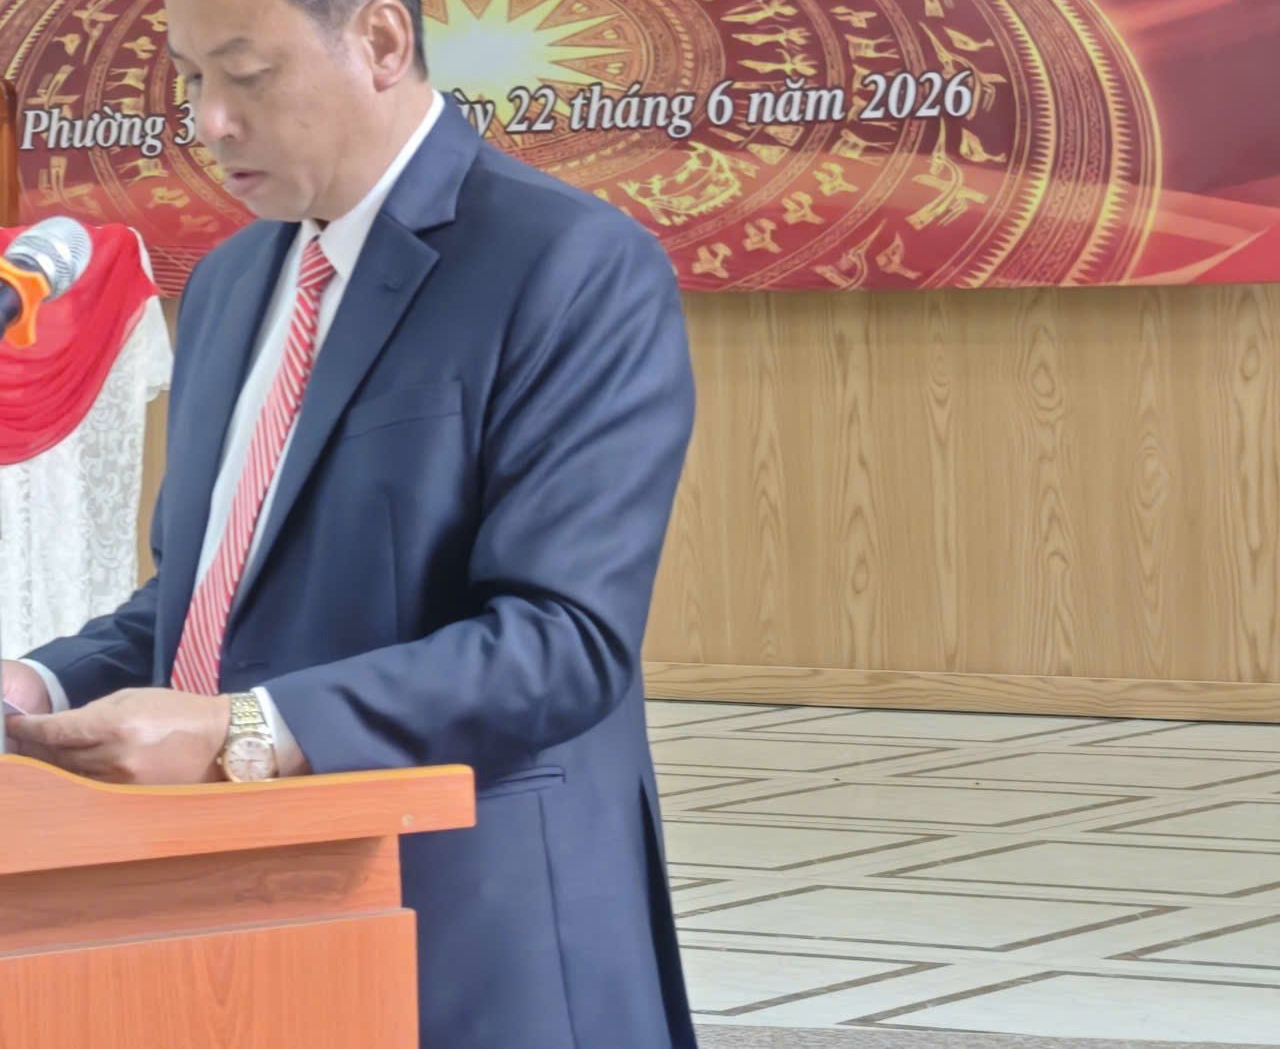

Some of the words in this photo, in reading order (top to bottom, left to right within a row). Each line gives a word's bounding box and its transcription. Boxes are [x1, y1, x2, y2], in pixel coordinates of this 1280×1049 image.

[20, 105, 166, 157] Phường
[504, 85, 556, 133] 22
[570, 82, 695, 139] tháng
[706, 79, 734, 125] 6
[747, 76, 846, 124] năm
[860, 70, 972, 119] 2026
